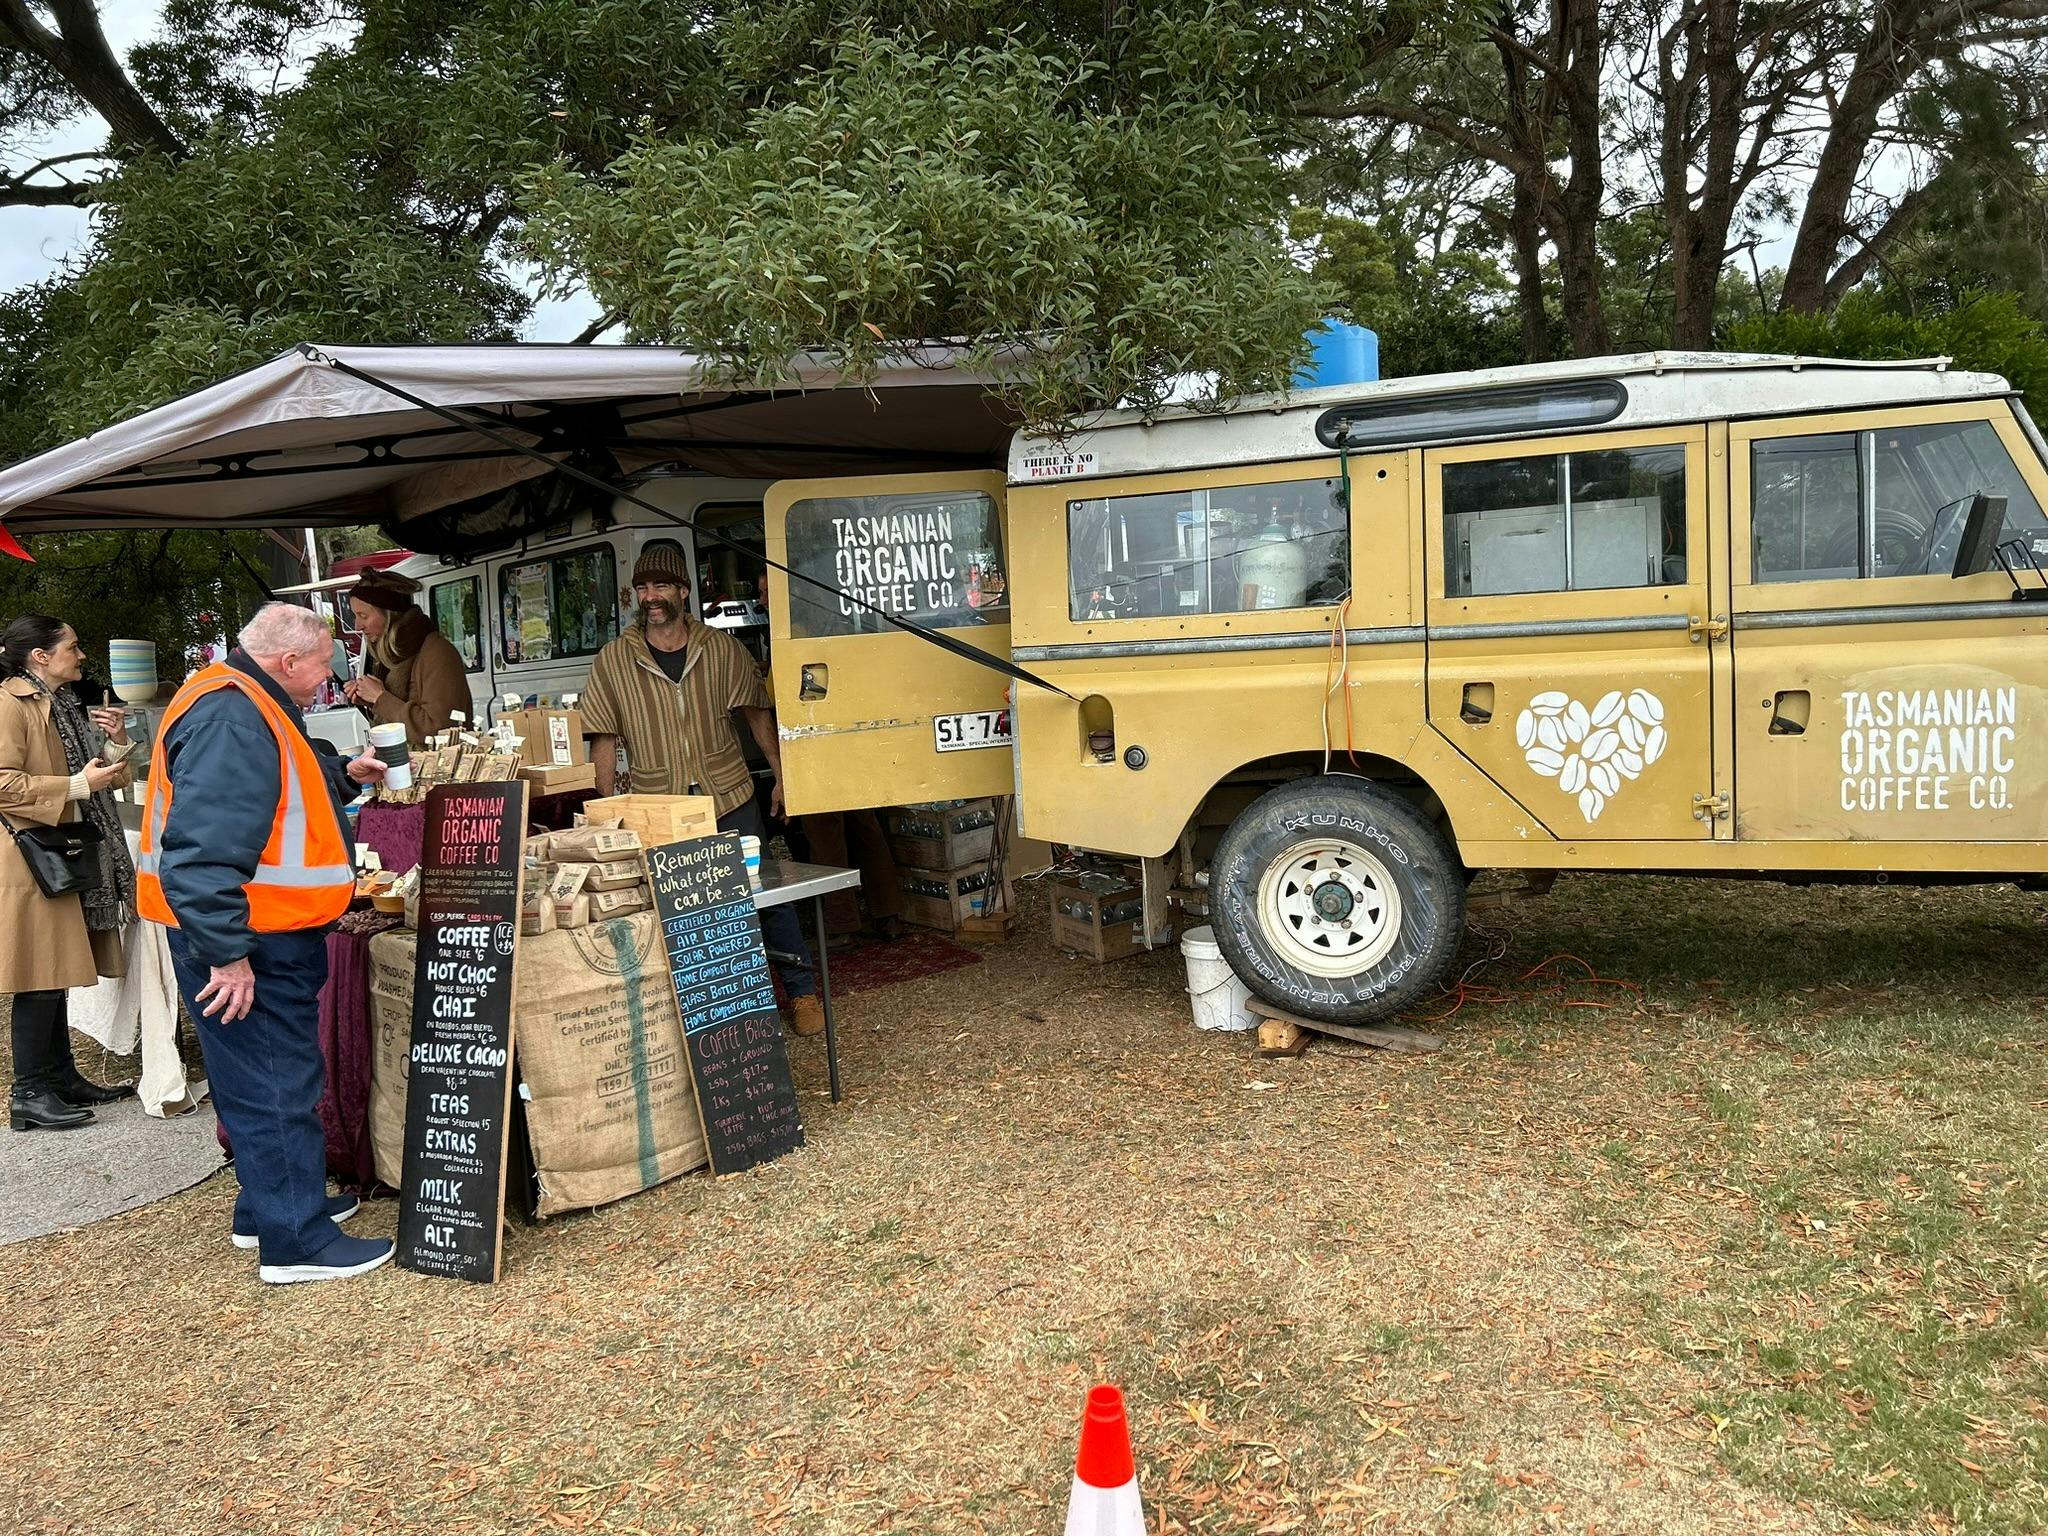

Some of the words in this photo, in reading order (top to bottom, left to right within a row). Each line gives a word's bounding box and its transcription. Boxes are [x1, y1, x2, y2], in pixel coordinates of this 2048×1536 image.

[1023, 456, 1060, 468] THERE
[1064, 455, 1074, 465] IS
[1078, 454, 1093, 464] NO
[1032, 465, 1073, 477] PLANET
[1077, 464, 1084, 473] B
[832, 512, 952, 548] TASMANIAN
[836, 542, 956, 587] ORGANIC
[840, 584, 917, 616] COFFEE
[928, 581, 958, 609] CO.
[1840, 686, 2016, 728] TASMANIAN
[1840, 726, 2016, 775] ORGANIC
[1841, 776, 1950, 812] COFFEE
[1968, 775, 2014, 810] CO.
[444, 796, 505, 818] TASMANIAN
[442, 820, 502, 844] ORGANIC
[1286, 811, 1409, 864] KUMHO
[440, 846, 478, 865] COFFEE
[485, 846, 500, 864] CO.
[653, 841, 736, 878] Reimagine
[659, 872, 693, 894] what
[696, 865, 734, 886] coffee
[674, 892, 704, 910] can
[668, 913, 712, 934] CERTIFIED
[714, 902, 756, 921] ORGANIC
[437, 926, 490, 948] COFFEE
[498, 926, 513, 939] ICE
[676, 932, 698, 948] AIR
[703, 920, 748, 941] ROASTED
[438, 948, 452, 958] ONE
[676, 949, 706, 968] SOLAR
[708, 935, 752, 959] POWERED
[428, 961, 458, 980] HOT
[458, 964, 497, 984] CHOC
[674, 971, 697, 990] HOME
[699, 962, 729, 982] COMPOST
[730, 957, 751, 974] COFFEE
[752, 954, 767, 967] BAGS
[1236, 931, 1351, 1004] VENTURE
[1356, 954, 1417, 1000] ROAD
[435, 984, 454, 994] HOUSE
[680, 991, 707, 1011] GLASS
[710, 982, 738, 999] BOTTLE
[742, 971, 769, 989] MILK
[759, 997, 773, 1006] LIDS
[432, 995, 477, 1018] CHAI
[554, 1003, 609, 1022] Timor-Leste
[684, 1011, 708, 1030] HOME
[710, 1002, 737, 1020] COMPOST
[434, 1031, 452, 1040] FRESH
[580, 1028, 618, 1046] Certified
[621, 1028, 631, 1038] by
[699, 1024, 740, 1058] COFFEE
[744, 1016, 775, 1044] BAGS
[412, 1042, 462, 1064] DELUXE
[466, 1045, 507, 1067] CACAO
[702, 1060, 727, 1076] BEANS
[739, 1043, 773, 1063] GROUND
[421, 1066, 435, 1074] DEAR
[436, 1067, 467, 1076] VALENTINE
[430, 1094, 470, 1115] TEAS
[714, 1112, 746, 1130] TURMERIC
[758, 1100, 774, 1115] HOT
[762, 1110, 779, 1123] CHOC
[426, 1115, 450, 1125] REQUEST
[723, 1122, 745, 1137] LATTE
[425, 1128, 477, 1154] EXTRAS
[420, 1178, 463, 1205] MILK
[425, 1223, 457, 1248] ALT.
